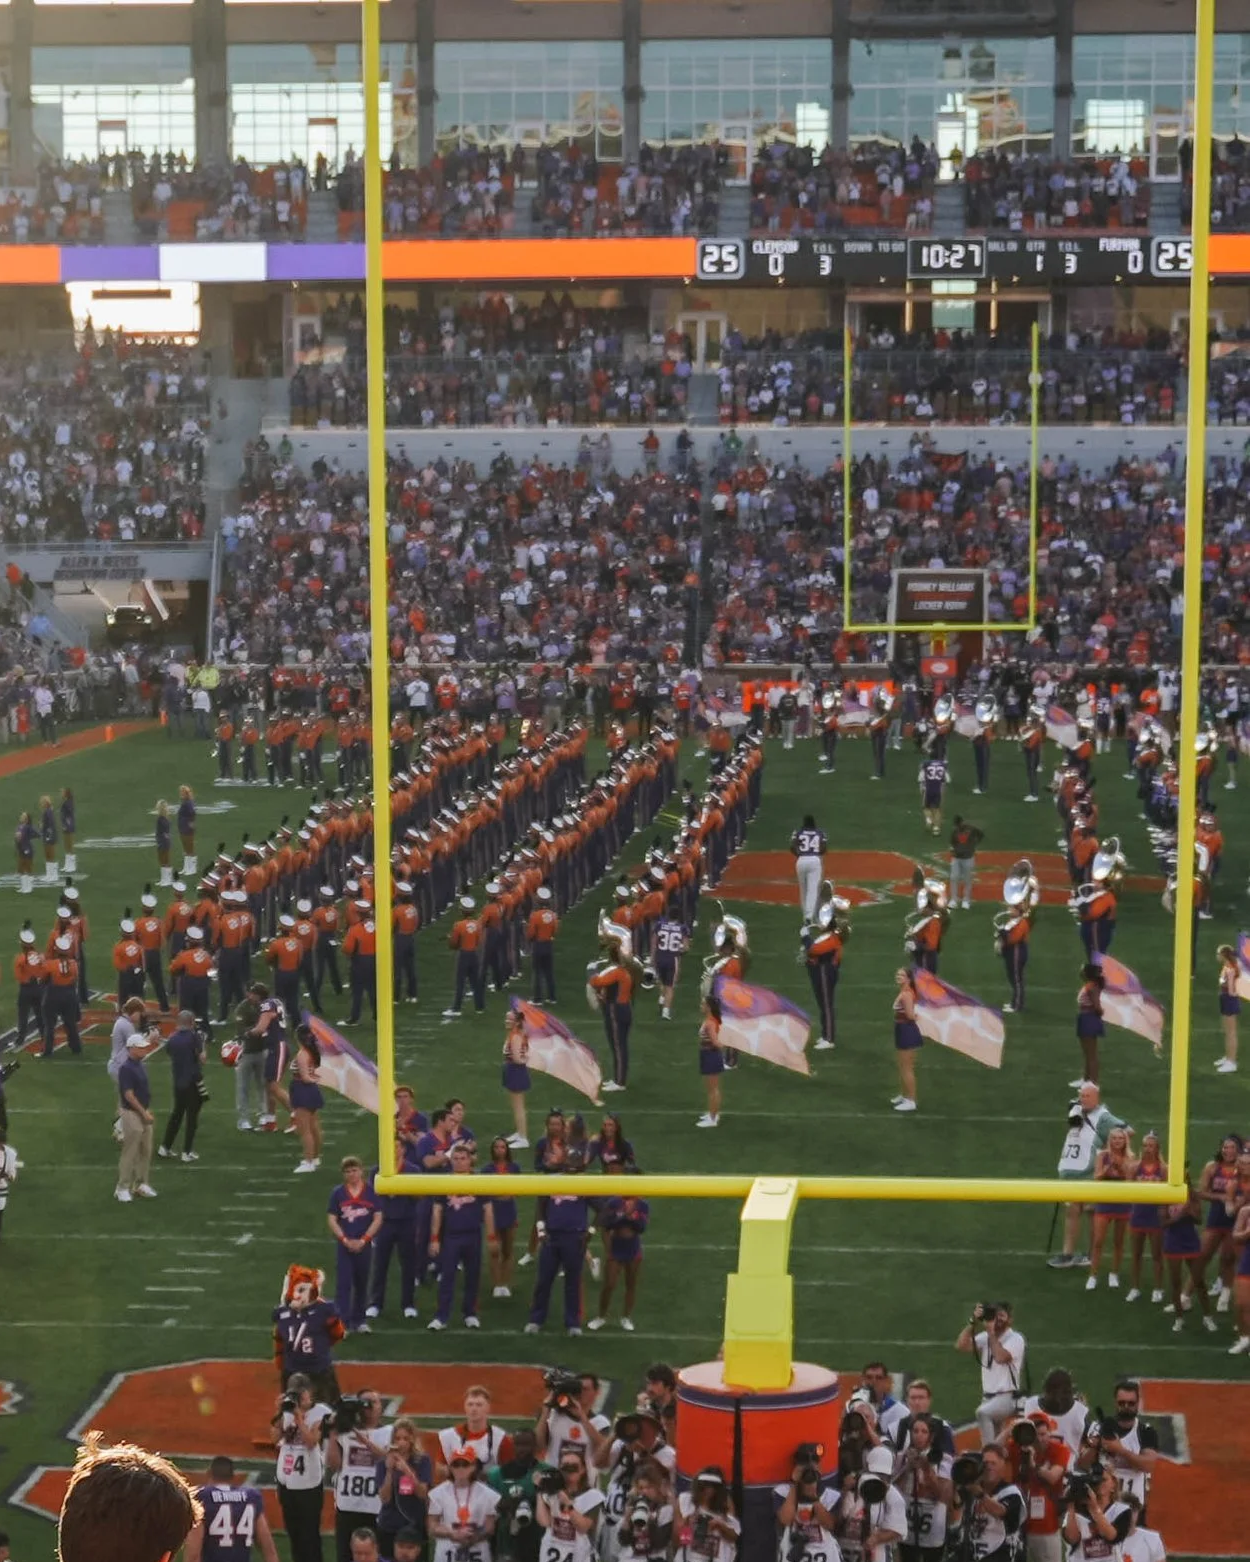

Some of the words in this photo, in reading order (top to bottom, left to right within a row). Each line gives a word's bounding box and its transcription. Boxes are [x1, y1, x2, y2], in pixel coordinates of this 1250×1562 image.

[752, 239, 799, 254] CLEMSON
[1099, 237, 1140, 252] FURMAN
[703, 245, 739, 273] 25
[768, 254, 785, 276] 0
[820, 255, 832, 276] 3
[922, 244, 982, 269] 10:27
[1065, 254, 1078, 274] 3
[1128, 252, 1144, 274] 0
[1158, 243, 1192, 270] 25
[798, 835, 820, 853] 34
[658, 930, 683, 952] 36
[340, 1475, 378, 1497] 180
[209, 1504, 255, 1547] 44
